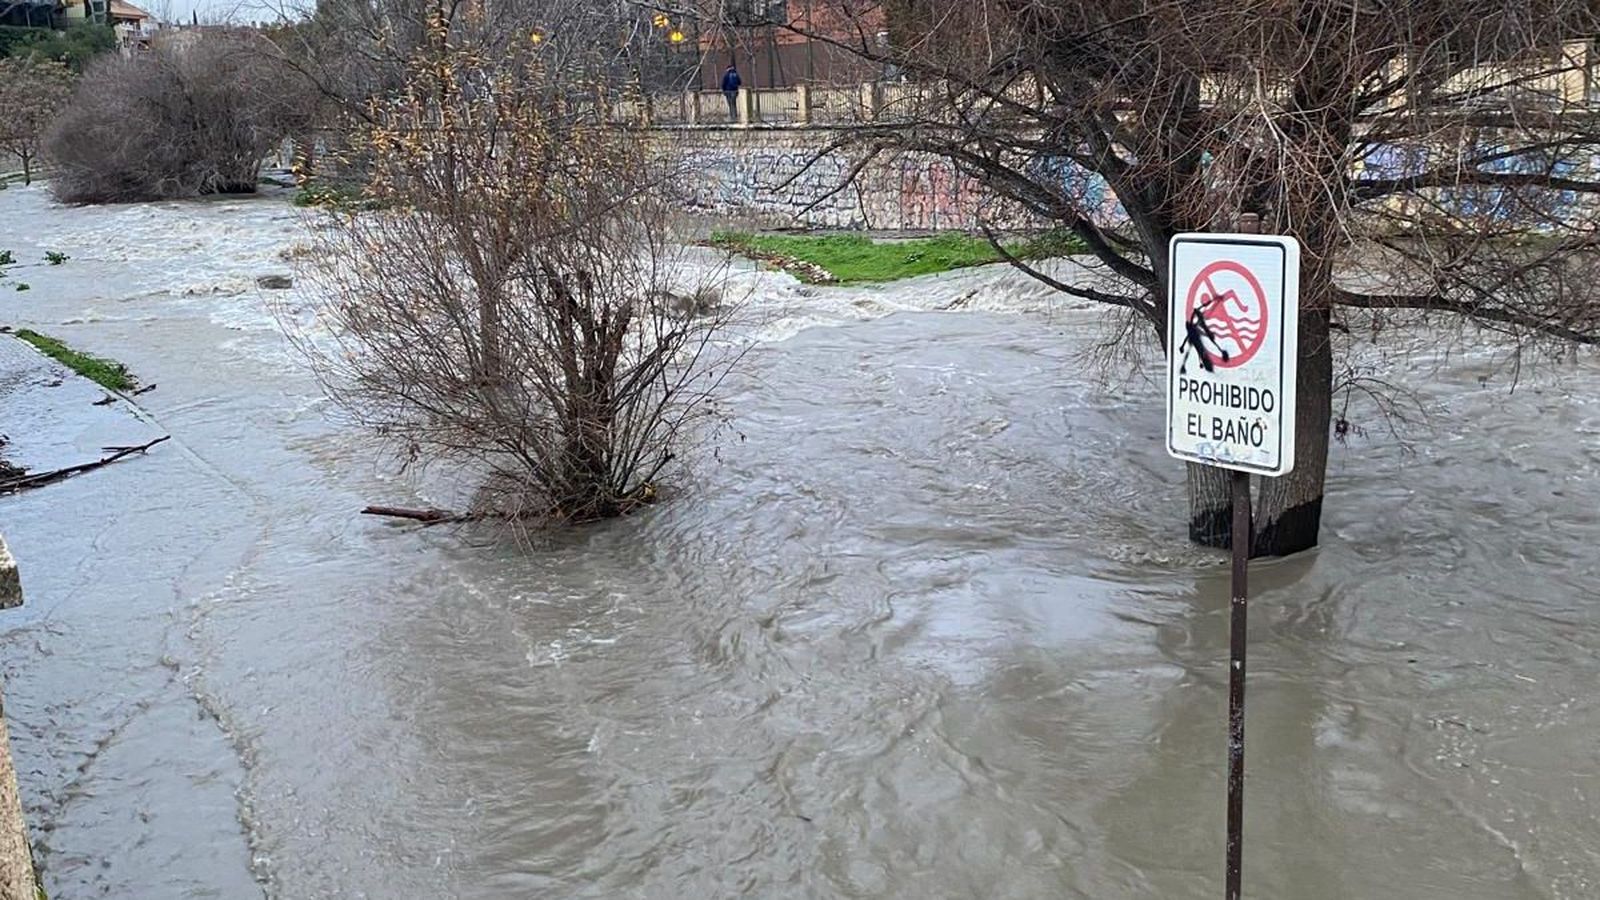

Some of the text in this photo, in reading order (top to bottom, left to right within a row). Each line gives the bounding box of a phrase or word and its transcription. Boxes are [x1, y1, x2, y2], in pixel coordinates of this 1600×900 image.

[1179, 378, 1274, 413] PROHIBIDO
[1187, 413, 1263, 447] EL BAÑO
